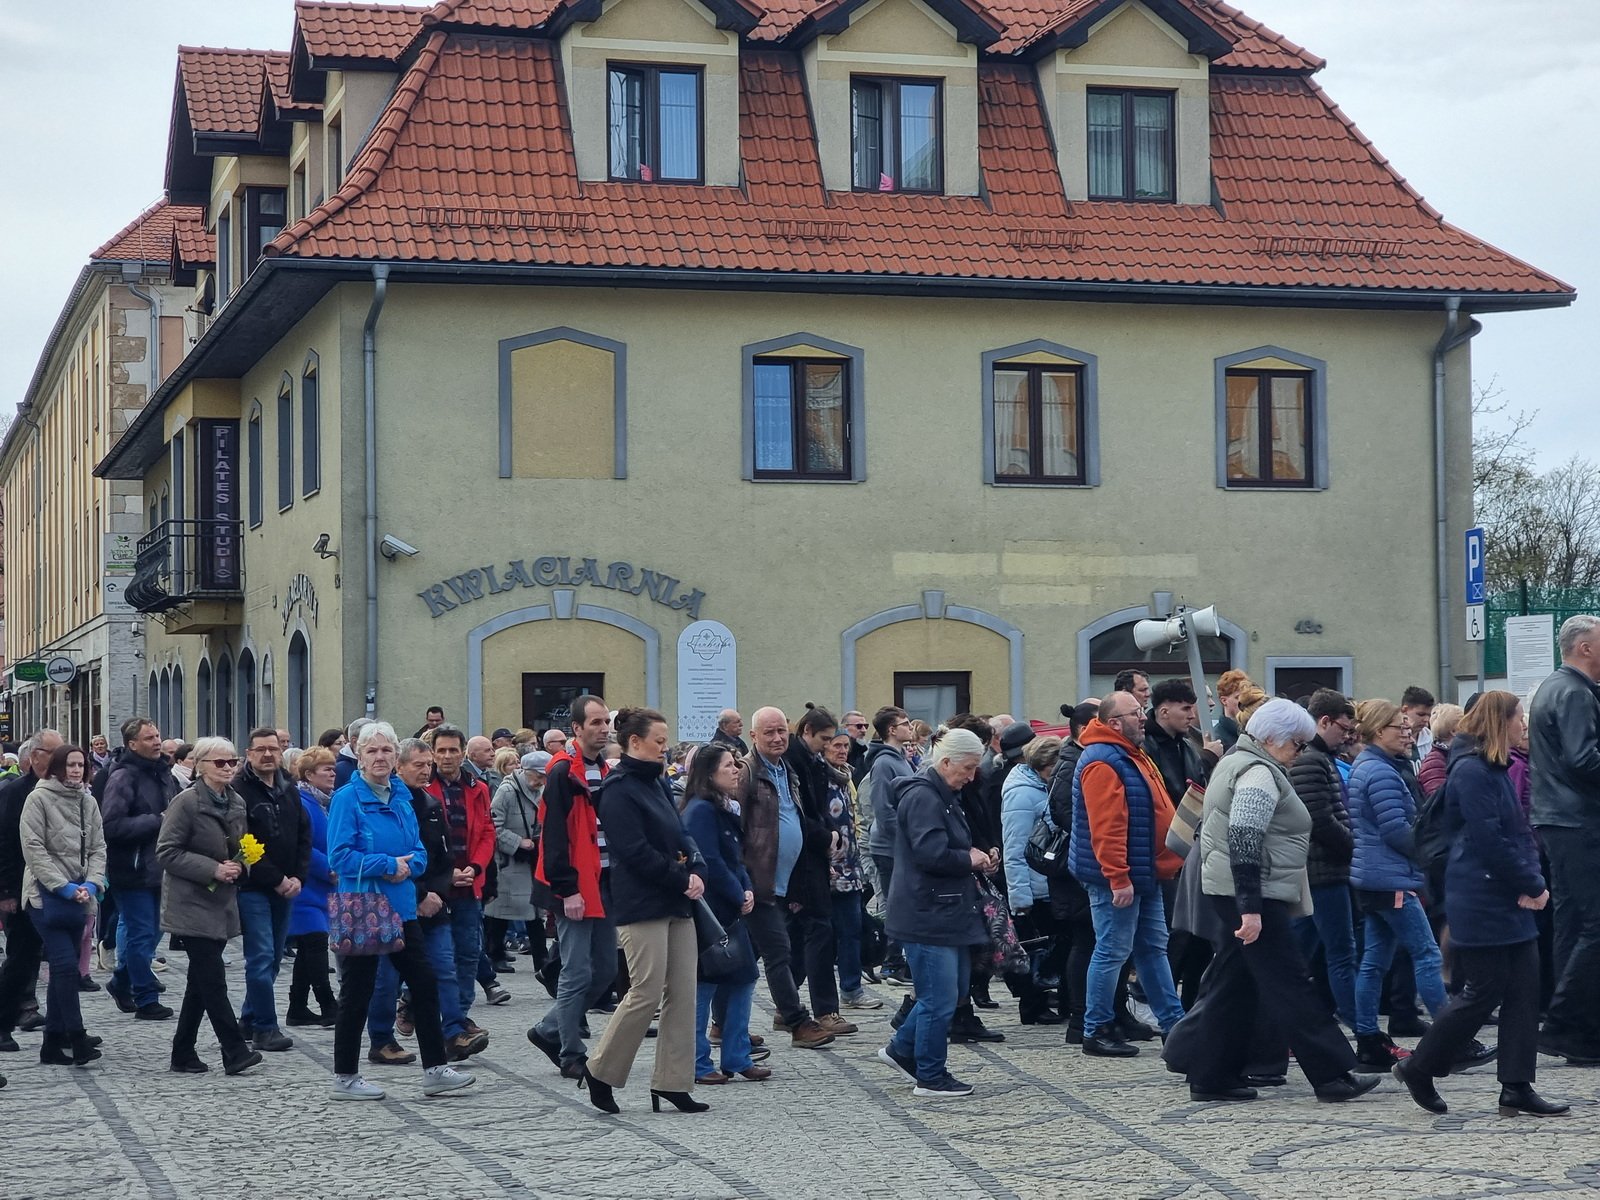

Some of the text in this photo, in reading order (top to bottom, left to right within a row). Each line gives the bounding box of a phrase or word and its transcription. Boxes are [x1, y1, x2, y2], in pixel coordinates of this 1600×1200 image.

[215, 428, 232, 578] PILATES STUDIO
[417, 556, 706, 619] KWIACIARNIA
[1468, 535, 1480, 582] P
